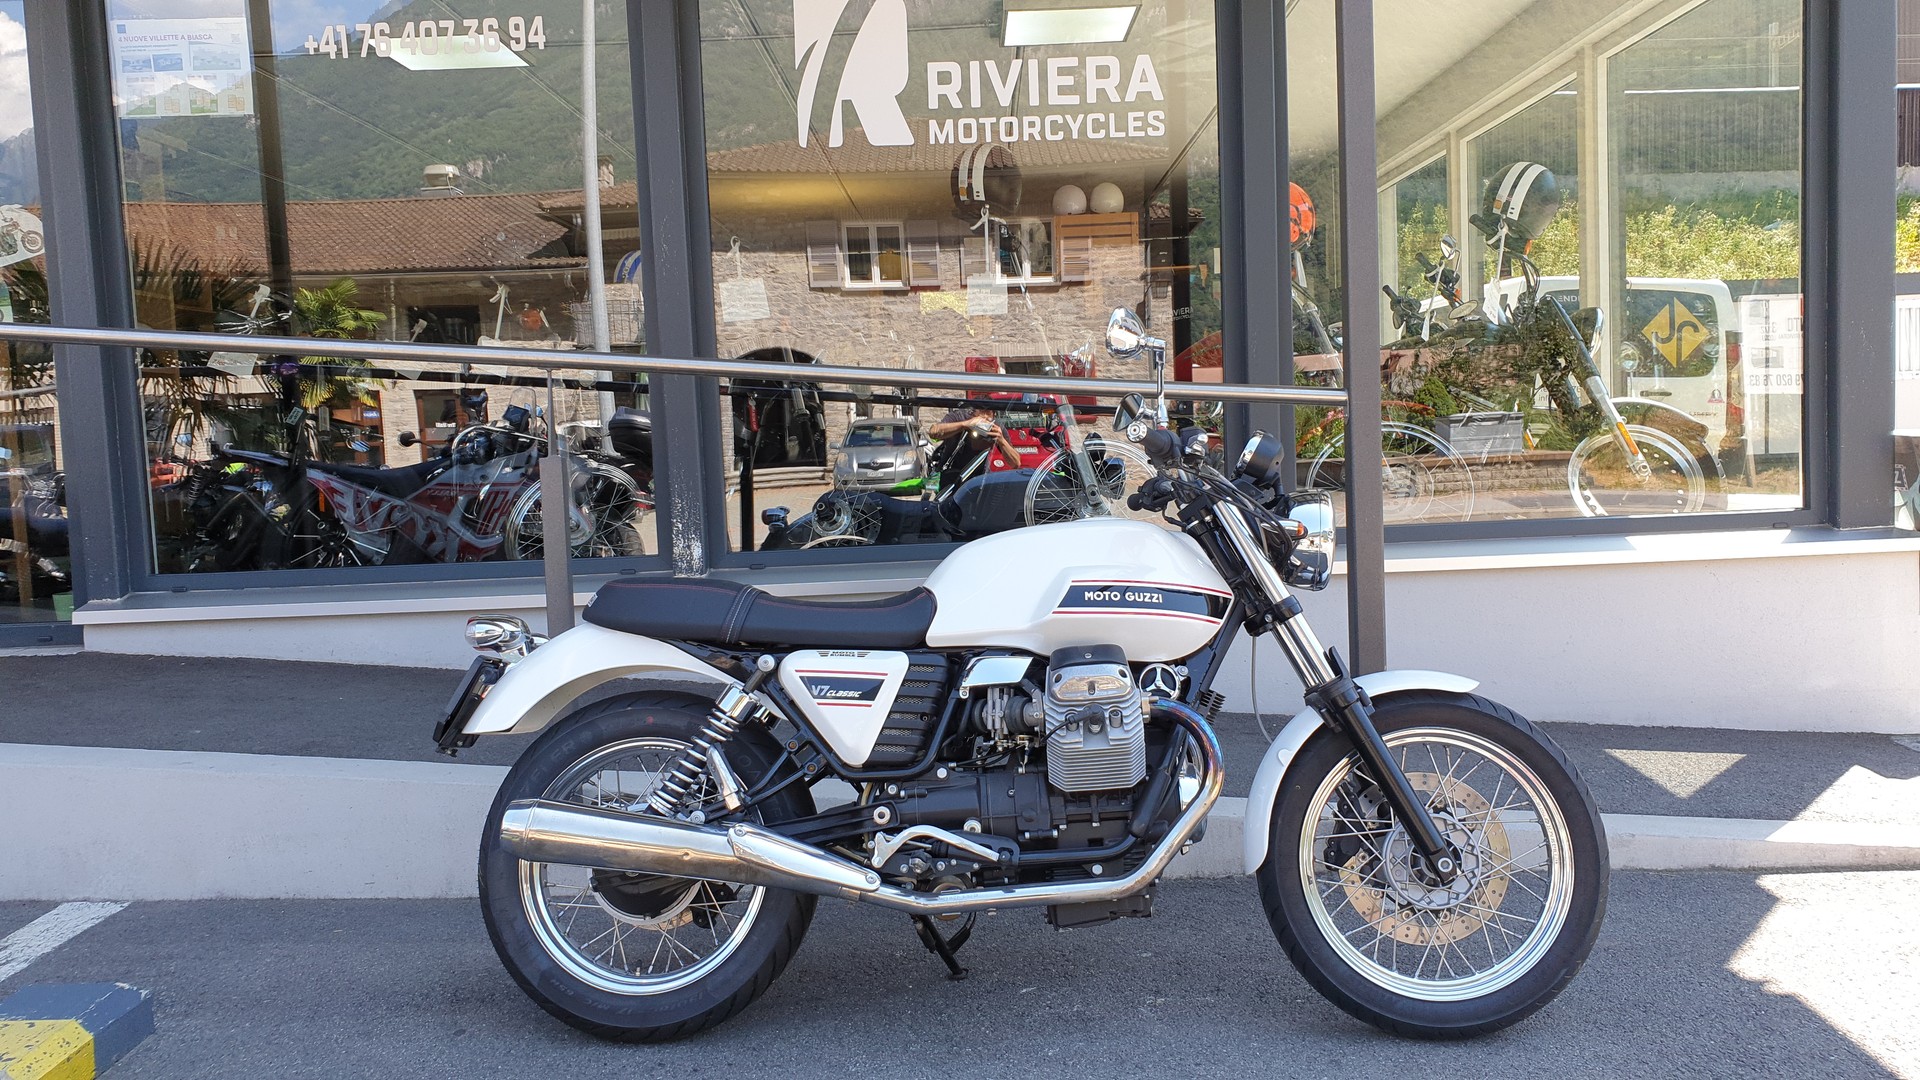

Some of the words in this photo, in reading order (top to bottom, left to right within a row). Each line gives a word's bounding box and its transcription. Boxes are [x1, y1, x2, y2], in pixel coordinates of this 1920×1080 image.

[187, 33, 214, 41] BIASCA
[304, 25, 349, 59] +41
[355, 22, 392, 58] 76
[400, 20, 455, 55] 407
[463, 18, 501, 54] 36
[508, 15, 546, 51] 94
[926, 54, 1165, 109] RIVIERA
[929, 110, 1166, 145] MOTORCYCLES
[1084, 591, 1121, 601] MOTO
[1125, 592, 1163, 603] GUZZI
[811, 684, 831, 696] V7
